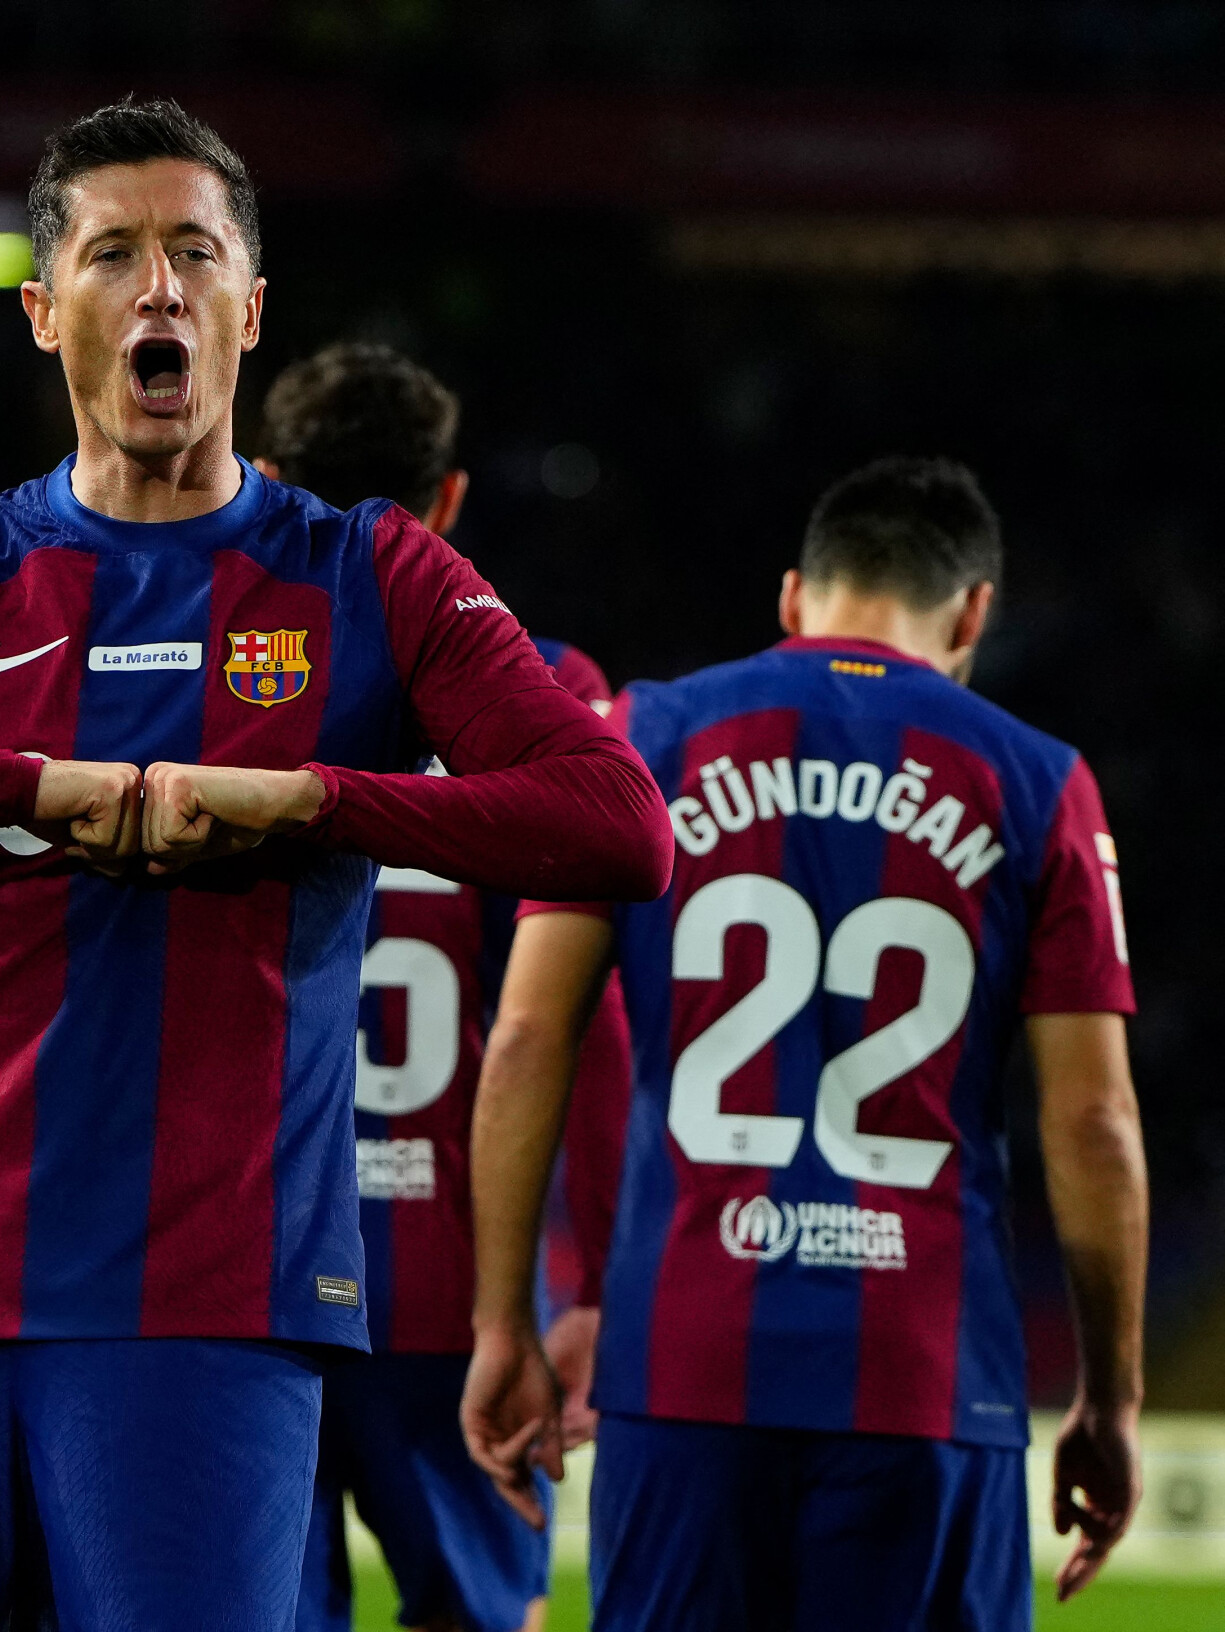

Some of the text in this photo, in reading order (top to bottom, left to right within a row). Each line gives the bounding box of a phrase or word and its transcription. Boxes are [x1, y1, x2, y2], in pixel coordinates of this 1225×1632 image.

[102, 650, 189, 665] La Marató
[668, 755, 1006, 890] GÜNDOĞAN
[668, 873, 975, 1190] 22
[797, 1202, 903, 1235] UNHCR
[796, 1228, 906, 1260] ACNUR
